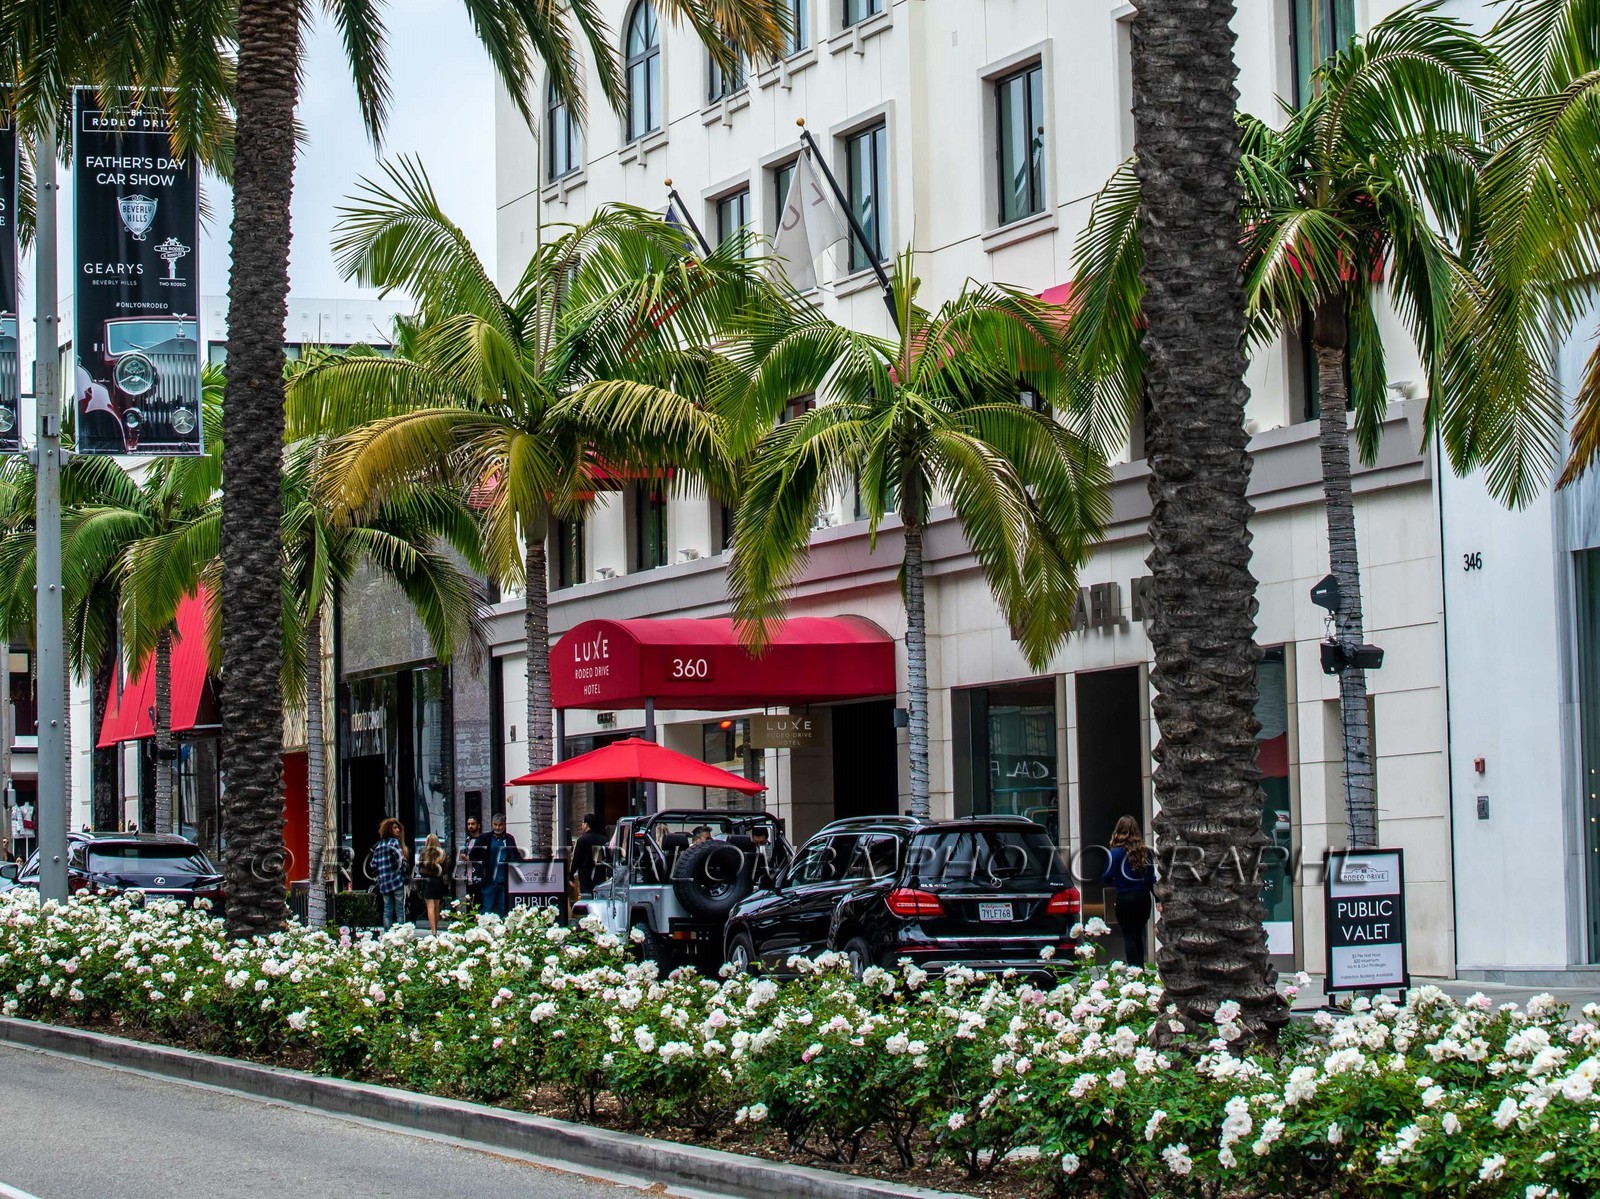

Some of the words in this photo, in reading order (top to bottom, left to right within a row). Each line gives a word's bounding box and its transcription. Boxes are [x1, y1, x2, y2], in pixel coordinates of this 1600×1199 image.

[86, 156, 153, 170] FATHER'S
[157, 158, 186, 170] DAY
[96, 173, 126, 185] CAR
[129, 174, 175, 186] SHOW
[122, 205, 152, 214] BEVERLY
[127, 214, 148, 223] HILLS
[83, 263, 144, 275] GEARYS
[116, 301, 169, 309] #ONLYONRODEO
[1463, 551, 1482, 571] 346
[574, 631, 609, 663] LUXE
[575, 667, 593, 679] RODEO
[594, 665, 610, 678] DRIVE
[672, 658, 708, 678] 360
[583, 684, 601, 695] HOTEL
[766, 717, 812, 731] LUXE
[514, 896, 559, 908] PUBLIC
[981, 909, 1011, 918] 7YLF768
[1337, 900, 1393, 919] PUBLIC
[1341, 923, 1390, 941] VALET
